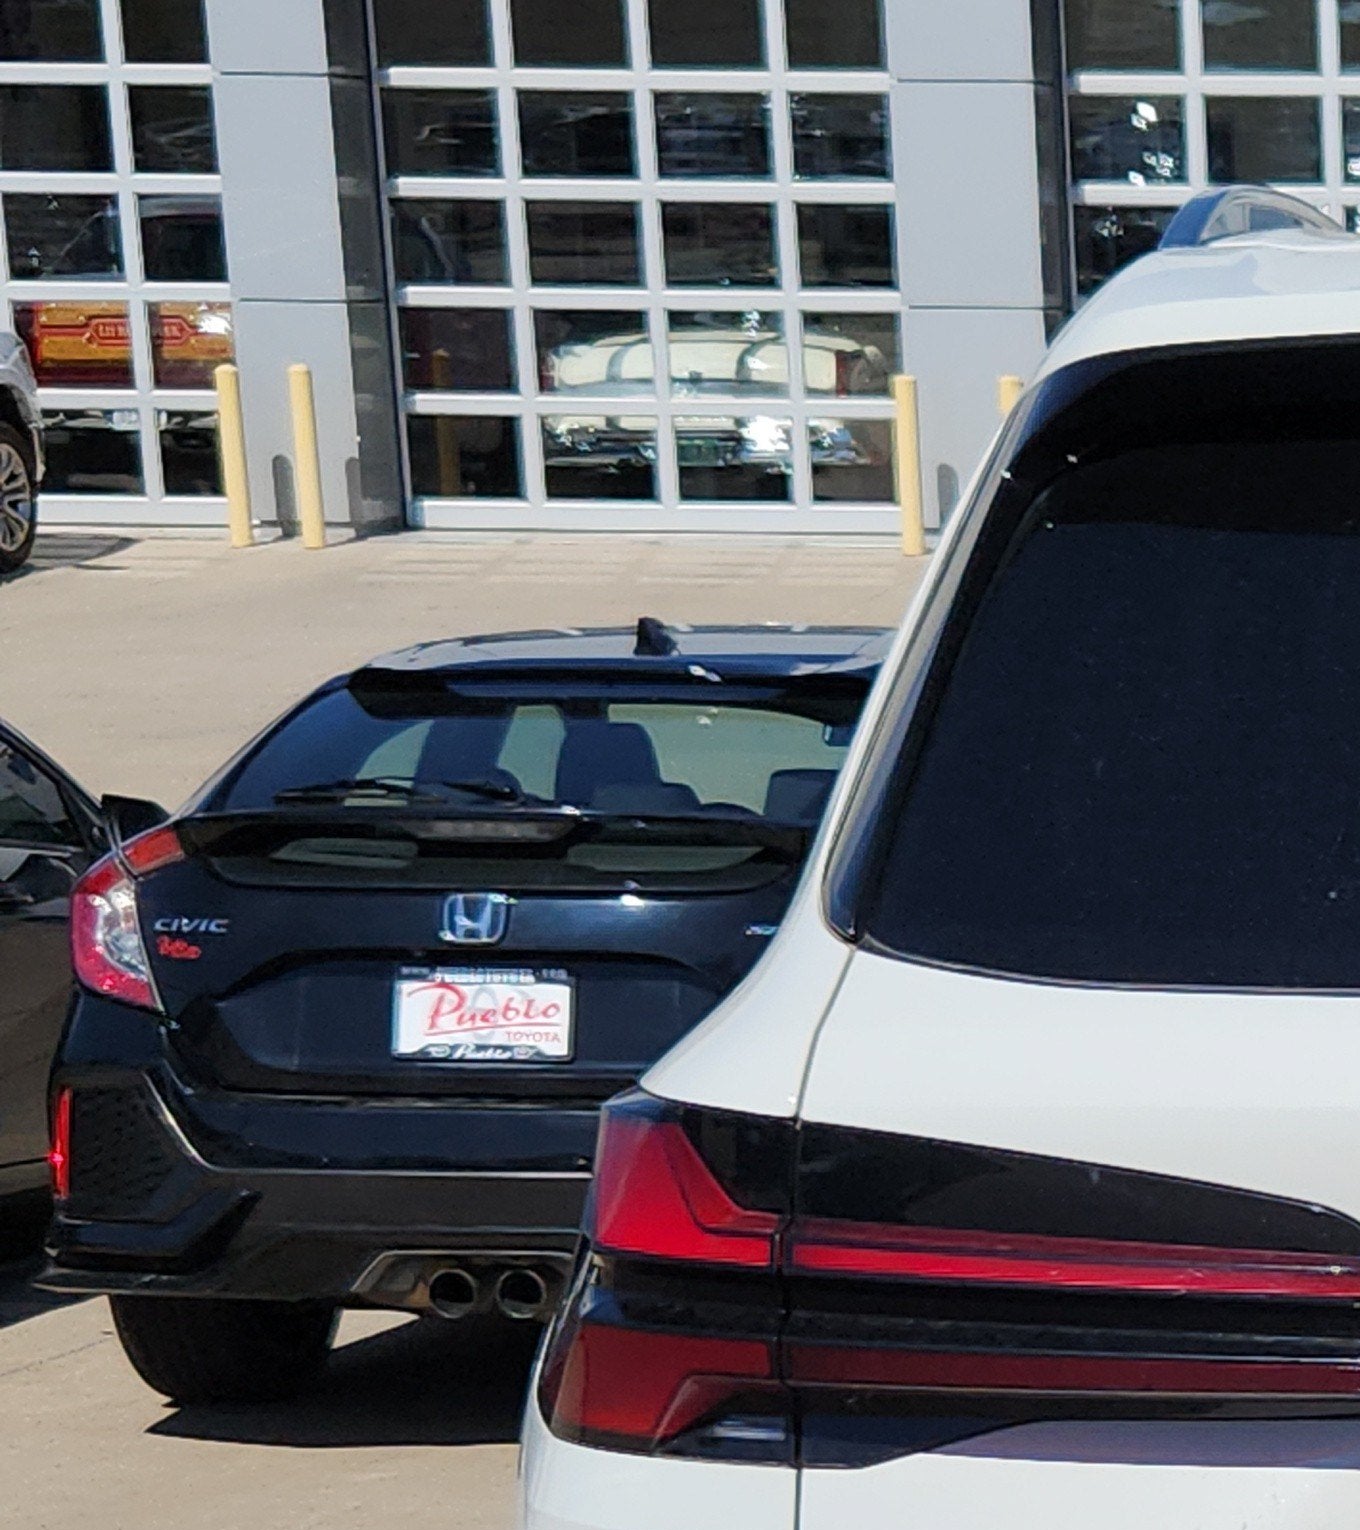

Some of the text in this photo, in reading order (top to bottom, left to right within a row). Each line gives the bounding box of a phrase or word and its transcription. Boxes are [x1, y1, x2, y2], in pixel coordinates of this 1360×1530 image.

[153, 917, 230, 933] CIVIC
[407, 980, 562, 1031] Pueblo
[505, 1031, 563, 1044] TOYOTA
